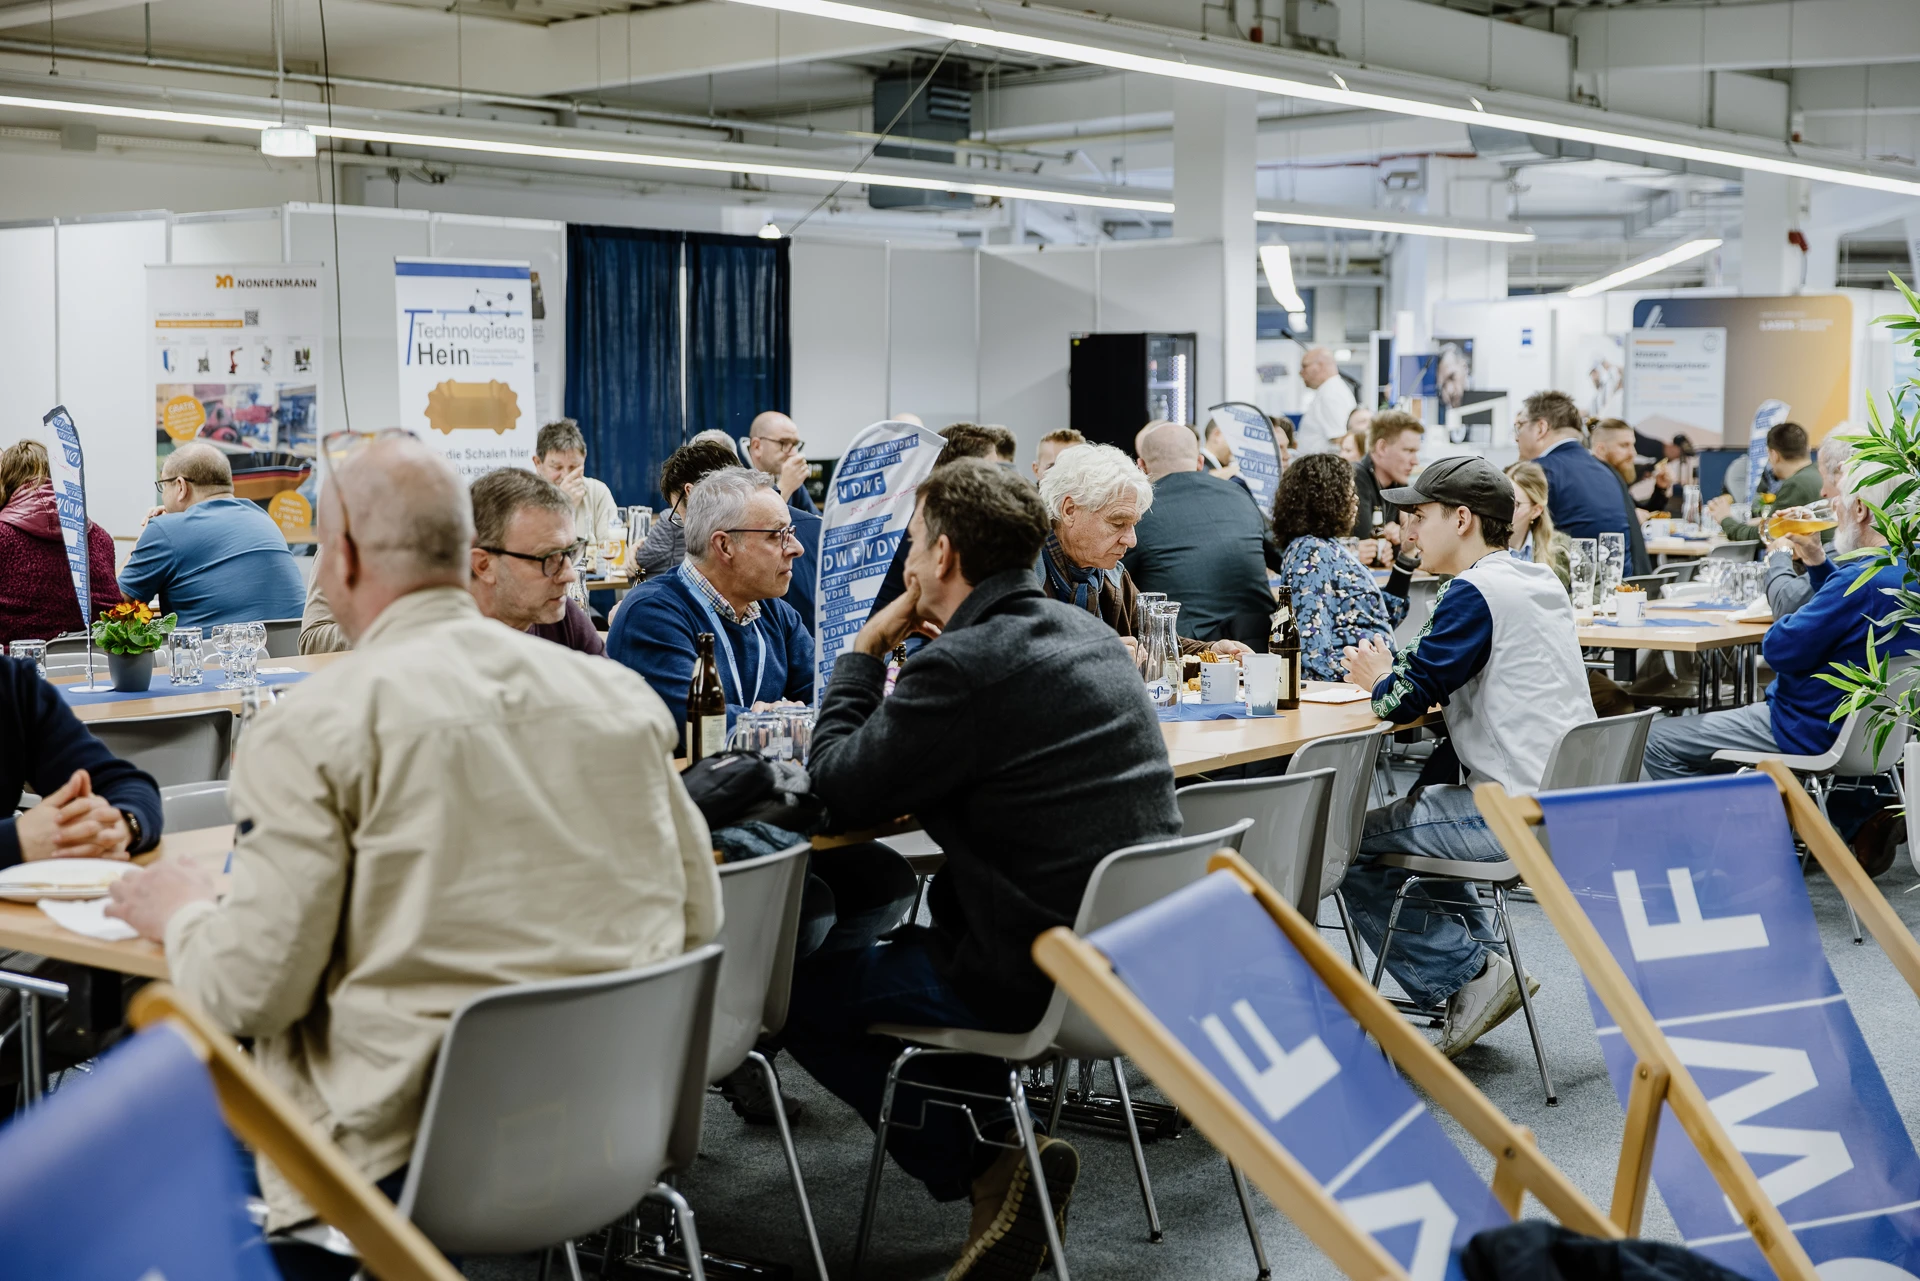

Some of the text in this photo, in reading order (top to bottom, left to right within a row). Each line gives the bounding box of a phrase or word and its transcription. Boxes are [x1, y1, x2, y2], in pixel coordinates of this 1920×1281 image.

[237, 279, 317, 288] NONNENMANN
[416, 322, 525, 343] Technologietag
[418, 343, 469, 365] Hein
[446, 446, 529, 460] die Schalen hier
[864, 444, 891, 458] VDWF
[892, 436, 918, 451] VDWF
[838, 476, 883, 500] VDWF
[843, 571, 862, 583] VDWF
[863, 564, 887, 577] VDWF
[825, 587, 850, 600] VDWF
[826, 607, 843, 618] VDWF
[844, 602, 862, 613] VDWF
[824, 622, 850, 639] VDWF
[823, 639, 843, 651] VDWF
